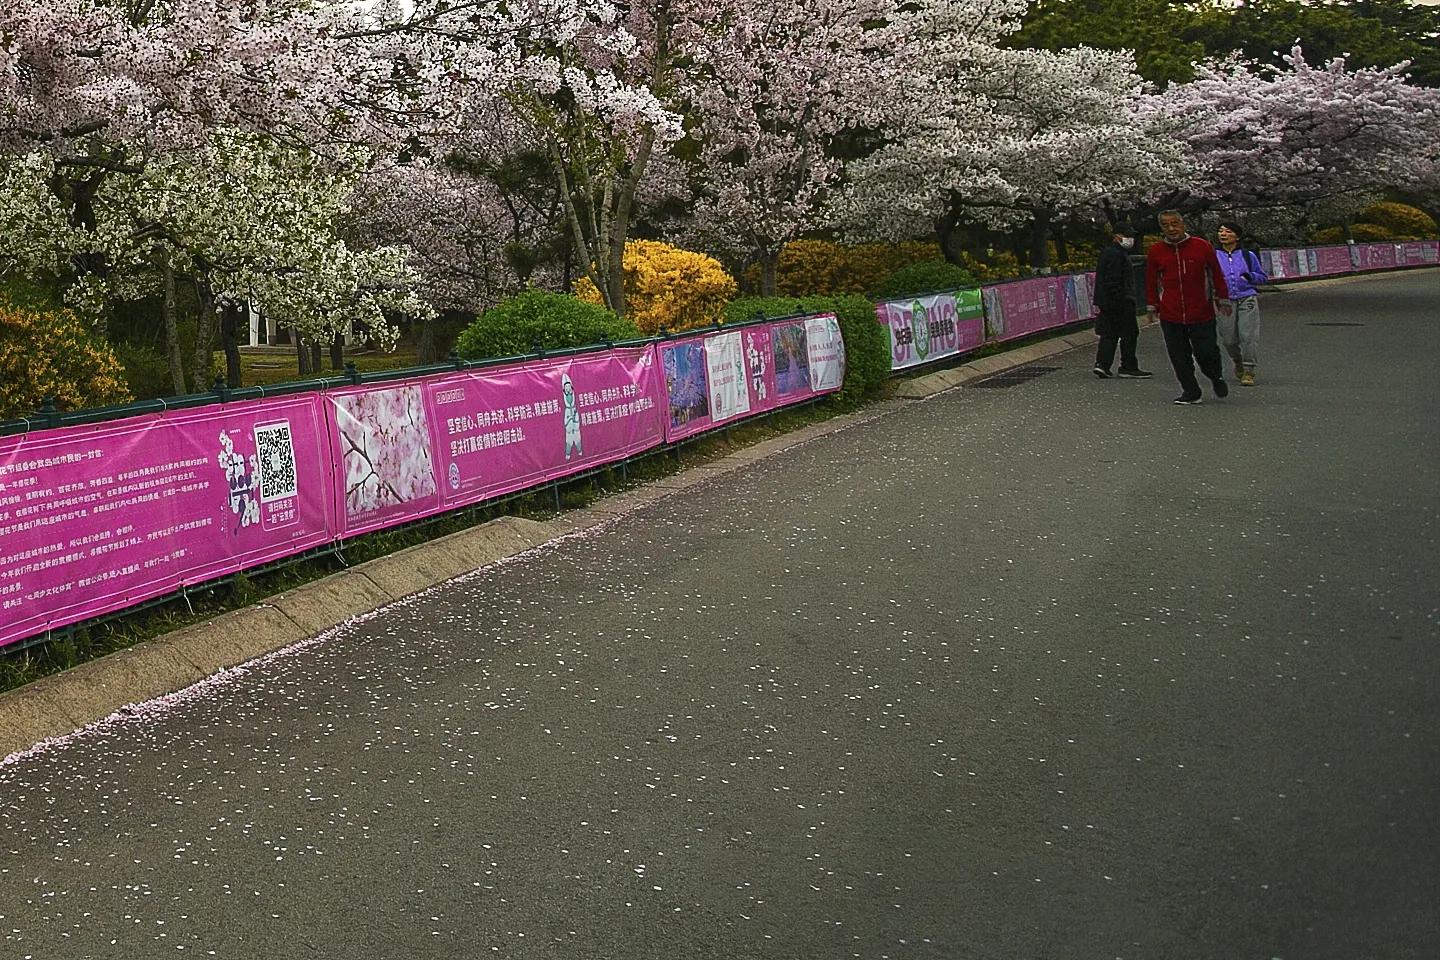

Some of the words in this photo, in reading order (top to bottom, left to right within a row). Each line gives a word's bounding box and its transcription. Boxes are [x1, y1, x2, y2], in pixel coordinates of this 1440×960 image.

[268, 498, 293, 513] 请扫码关注
